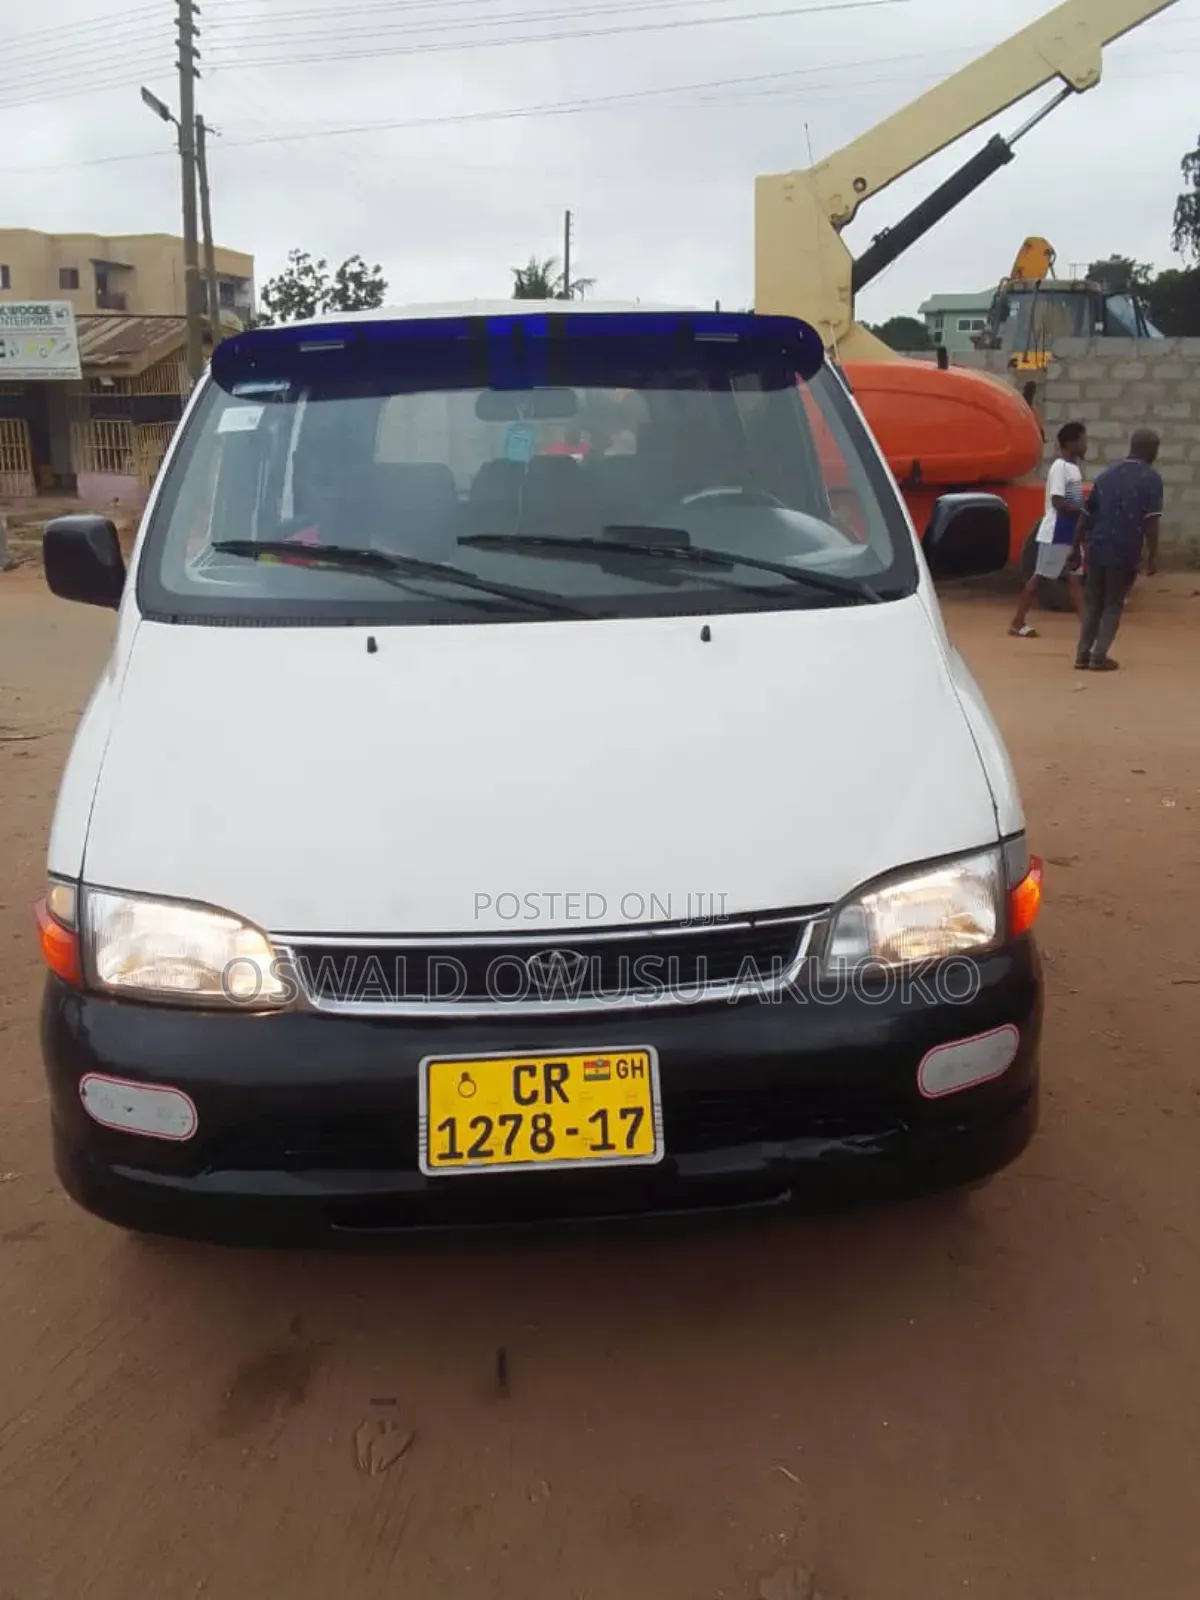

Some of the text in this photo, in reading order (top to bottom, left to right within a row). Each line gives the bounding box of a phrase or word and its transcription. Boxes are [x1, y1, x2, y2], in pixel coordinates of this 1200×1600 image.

[512, 1063, 570, 1105] CR
[615, 1059, 644, 1079] GH
[437, 1107, 644, 1160] 1278-17
